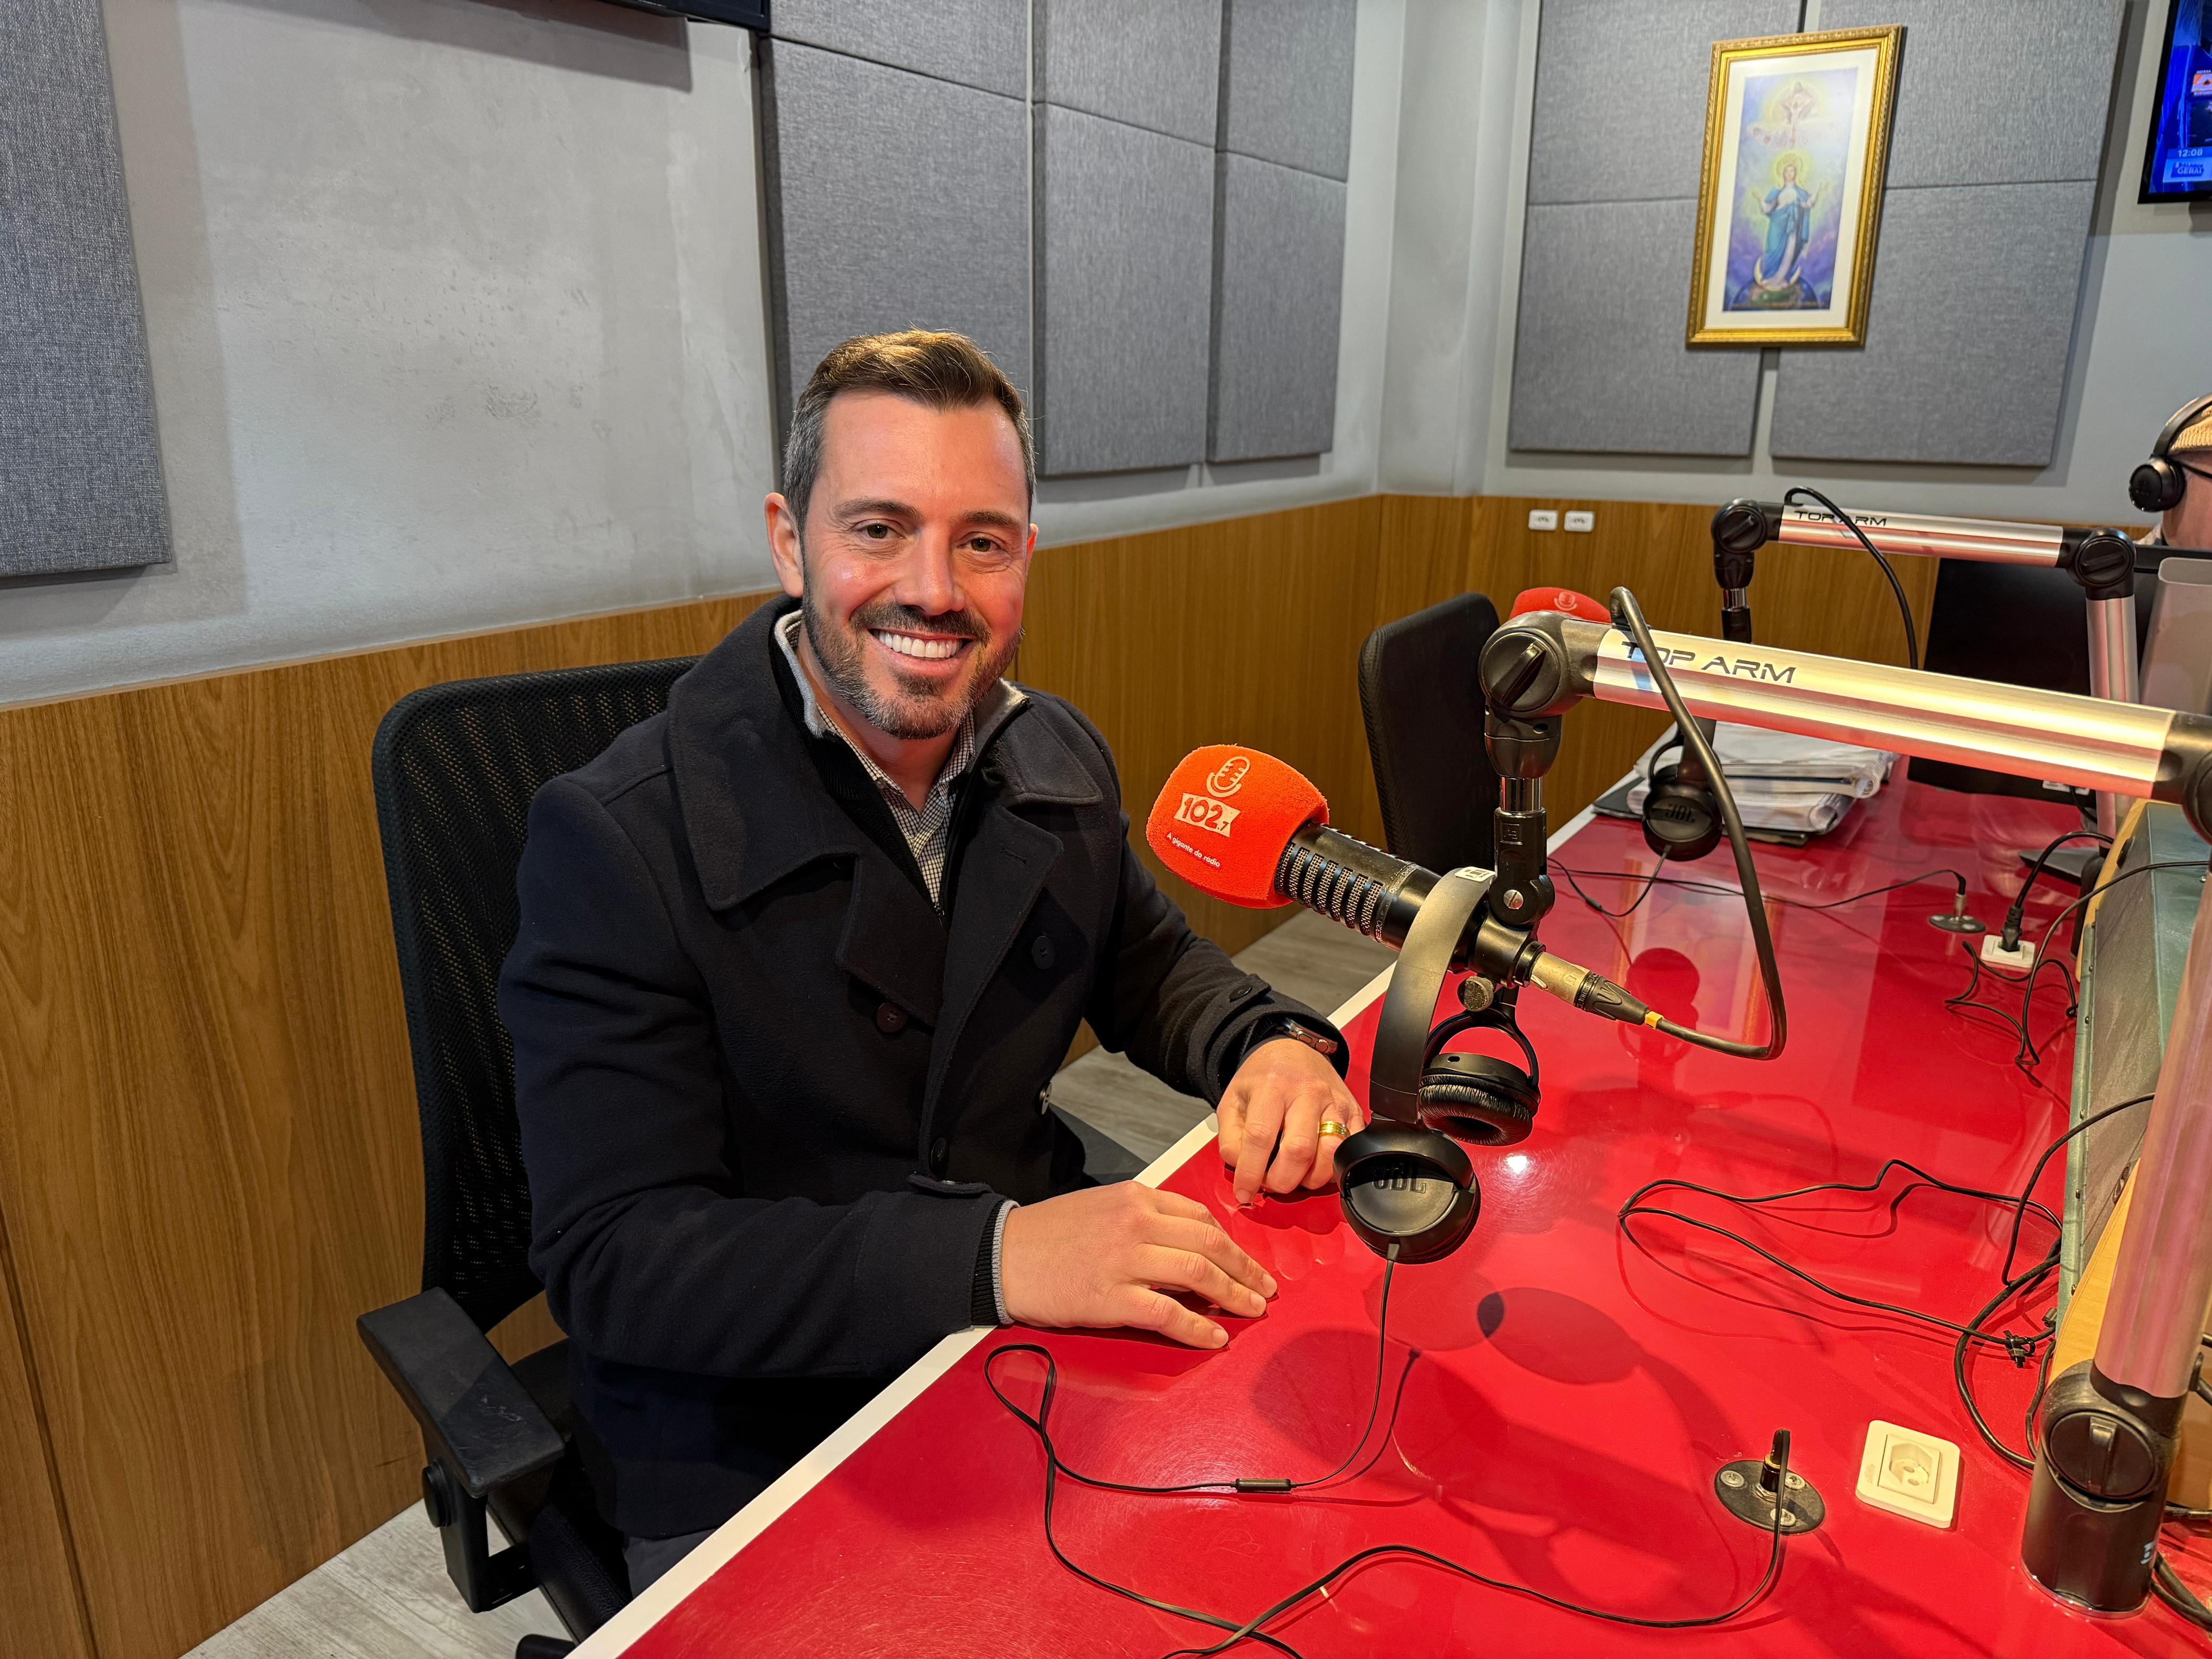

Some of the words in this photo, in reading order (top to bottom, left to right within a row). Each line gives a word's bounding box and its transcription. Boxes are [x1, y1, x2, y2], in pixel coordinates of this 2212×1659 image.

[2178, 148, 2203, 157] 12:08
[1795, 510, 1834, 522] TOP
[1701, 657, 1796, 684] ARM
[1182, 798, 1229, 831] 102.7
[1167, 832, 1172, 840] A
[1172, 837, 1194, 853] gigante
[1194, 849, 1203, 858] do
[1203, 856, 1221, 867] rádio
